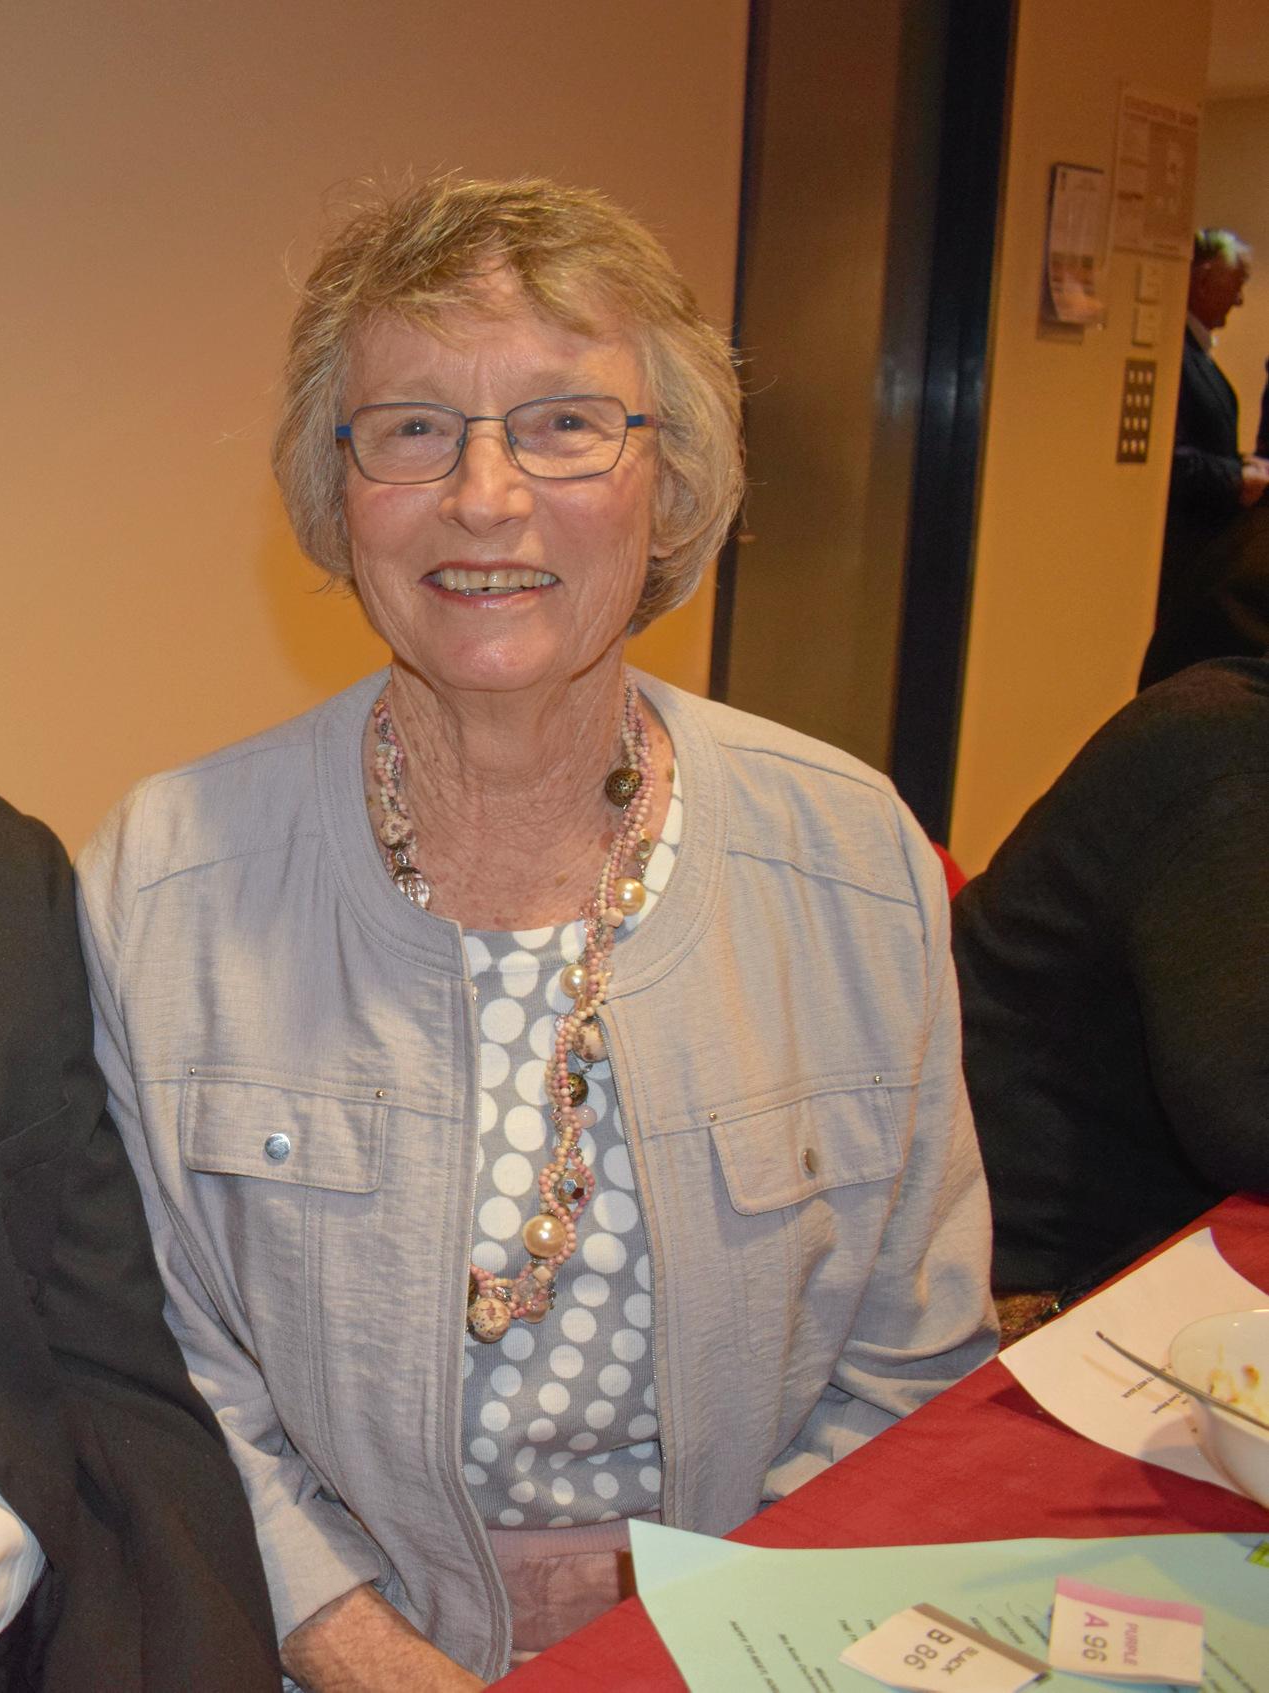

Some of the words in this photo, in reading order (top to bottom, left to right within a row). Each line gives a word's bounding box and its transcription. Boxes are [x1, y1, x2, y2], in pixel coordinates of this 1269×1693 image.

[1084, 1611, 1110, 1628] A
[926, 1628, 954, 1645] B
[1082, 1634, 1108, 1662] 96
[1123, 1622, 1139, 1666] PURPLE
[903, 1644, 938, 1670] 86
[941, 1646, 979, 1675] BLACK
